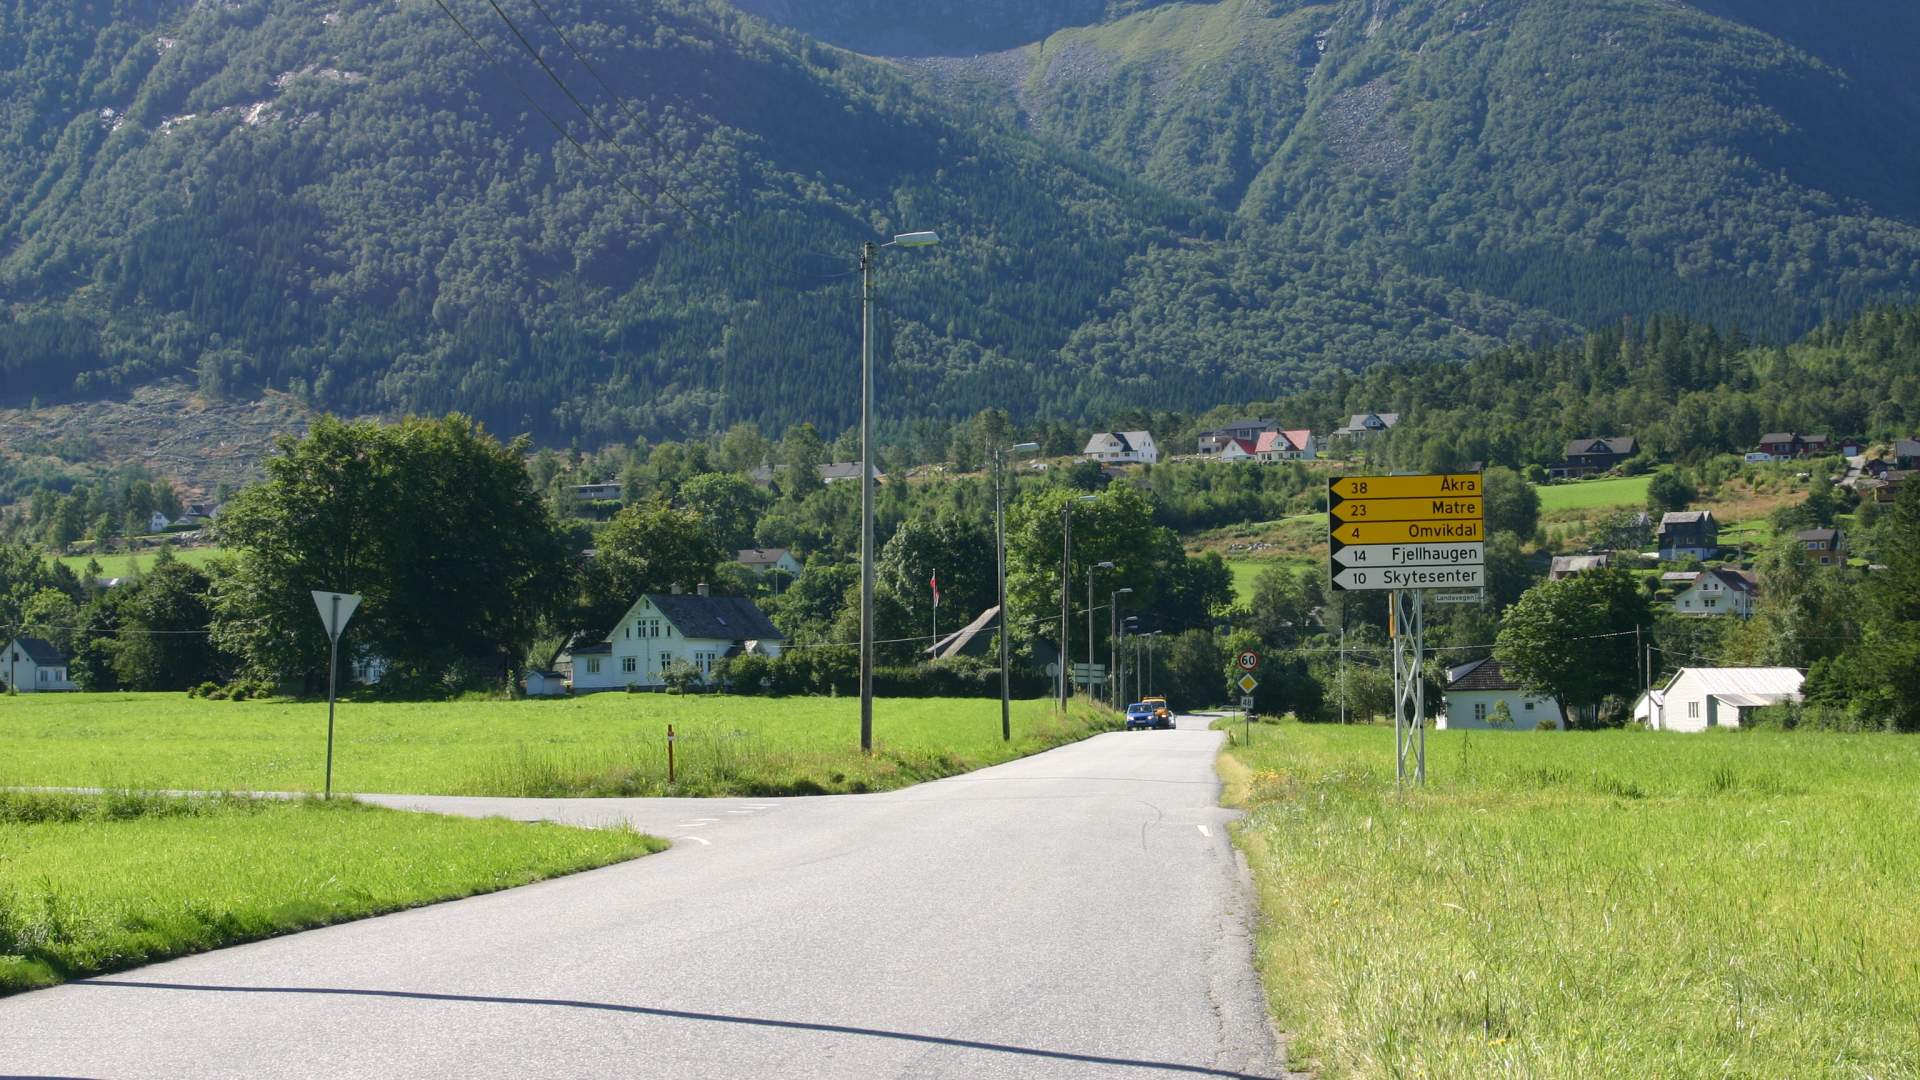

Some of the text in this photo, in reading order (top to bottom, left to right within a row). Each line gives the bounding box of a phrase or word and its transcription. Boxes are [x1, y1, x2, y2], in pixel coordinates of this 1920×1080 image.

[1351, 475, 1475, 494] 38 Åkra
[1351, 501, 1476, 516] 23 Matre
[1352, 524, 1476, 538] 4 Omvikdal
[1353, 547, 1477, 564] 14 Fjellhaugen
[1353, 569, 1477, 586] 10 Skytesenter
[1241, 655, 1255, 666] 60
